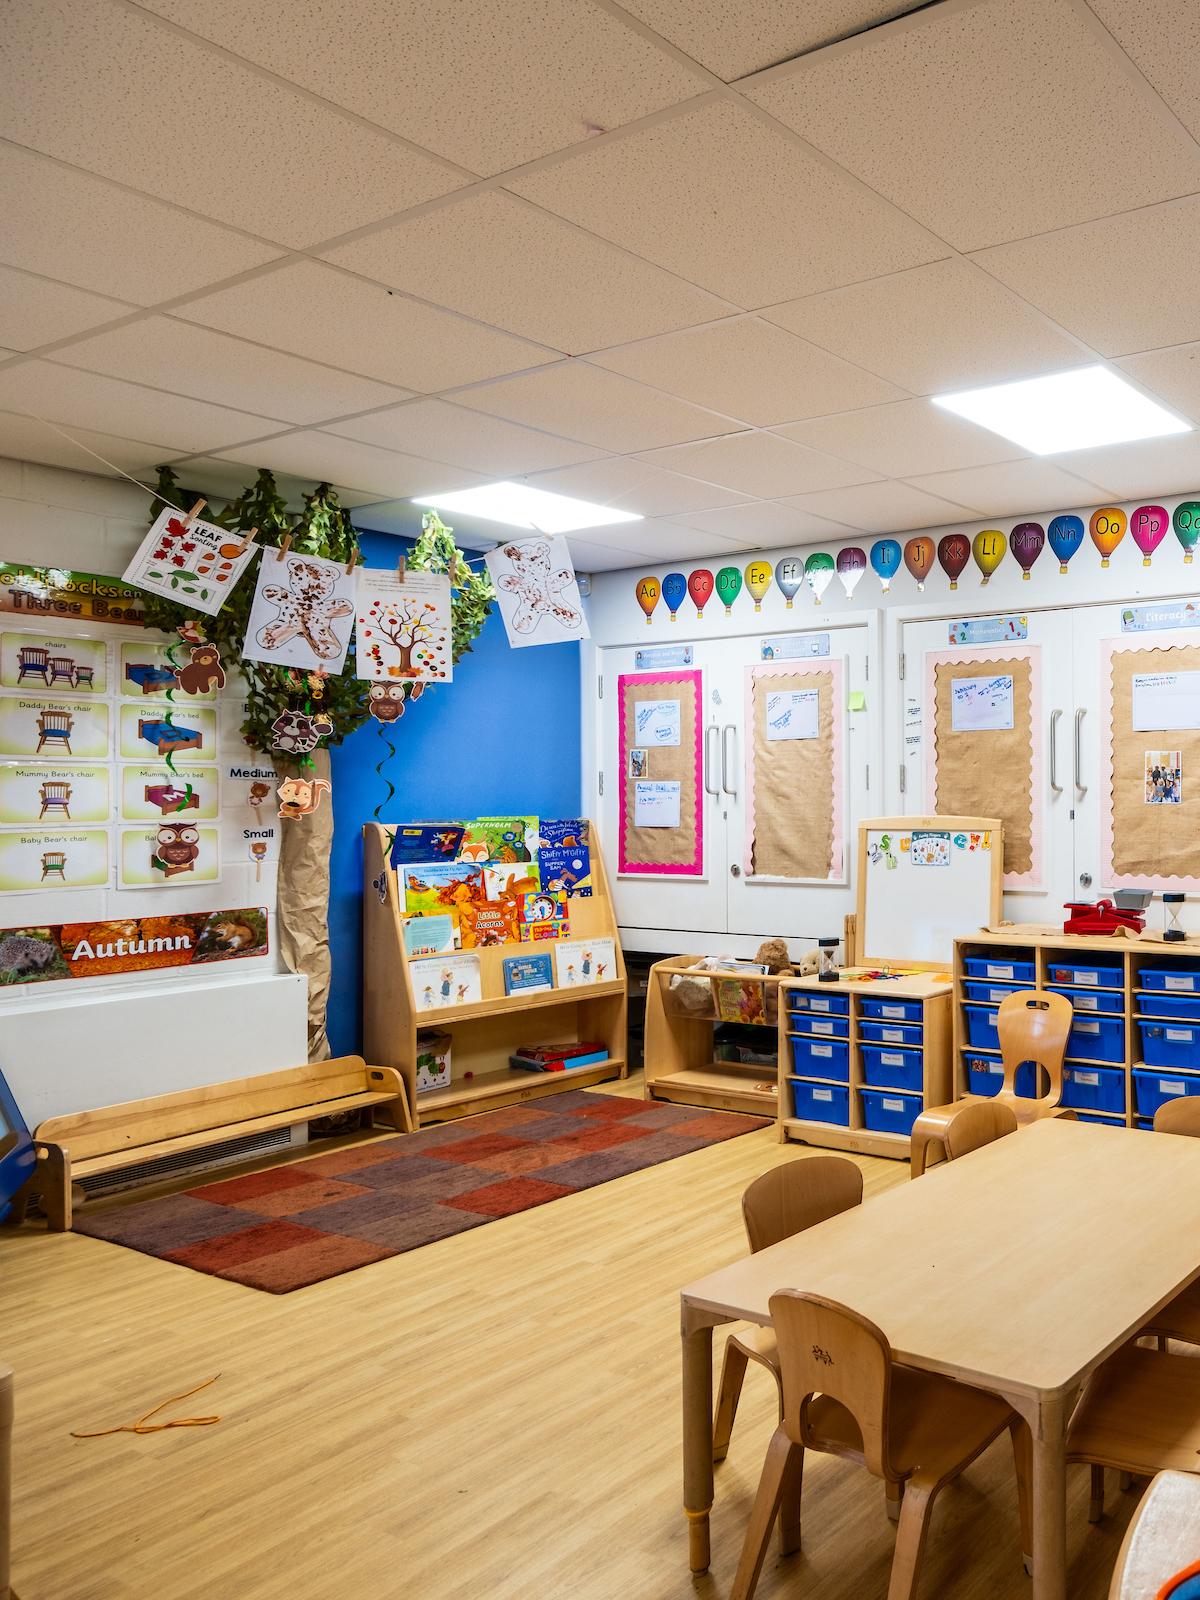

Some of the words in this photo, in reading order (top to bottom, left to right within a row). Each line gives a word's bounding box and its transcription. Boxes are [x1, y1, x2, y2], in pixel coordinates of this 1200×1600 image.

[1053, 524, 1076, 541] Nn
[1095, 517, 1120, 534] Oo
[1138, 514, 1159, 537] Pp
[189, 533, 218, 551] Sorting
[194, 526, 223, 542] LEAF
[1012, 534, 1042, 550] Mm
[880, 546, 890, 563] Ii
[944, 543, 963, 561] Kk
[982, 538, 996, 556] Ll
[913, 544, 925, 567] Jj
[751, 568, 765, 584] Ee
[783, 564, 796, 580] Ff
[666, 579, 682, 595] Bb
[693, 576, 708, 591] Cc
[720, 573, 738, 590] Dd
[123, 589, 143, 599] an
[640, 584, 657, 598] Aa
[8, 589, 82, 613] Three
[1145, 611, 1187, 623] Literacy
[45, 641, 67, 649] chairs
[19, 701, 46, 711] Daddy
[48, 703, 71, 711] Bear's
[140, 710, 164, 718] Daddy
[15, 770, 48, 779] Mummy
[51, 770, 75, 778] Bear's
[140, 771, 167, 779] Mummy
[230, 768, 278, 778] Medium
[21, 836, 42, 845] Baby
[44, 835, 67, 843] Bear's
[243, 829, 274, 839] Small
[477, 911, 501, 920] Little
[476, 920, 504, 929] Acorns
[71, 933, 193, 961] Autumn
